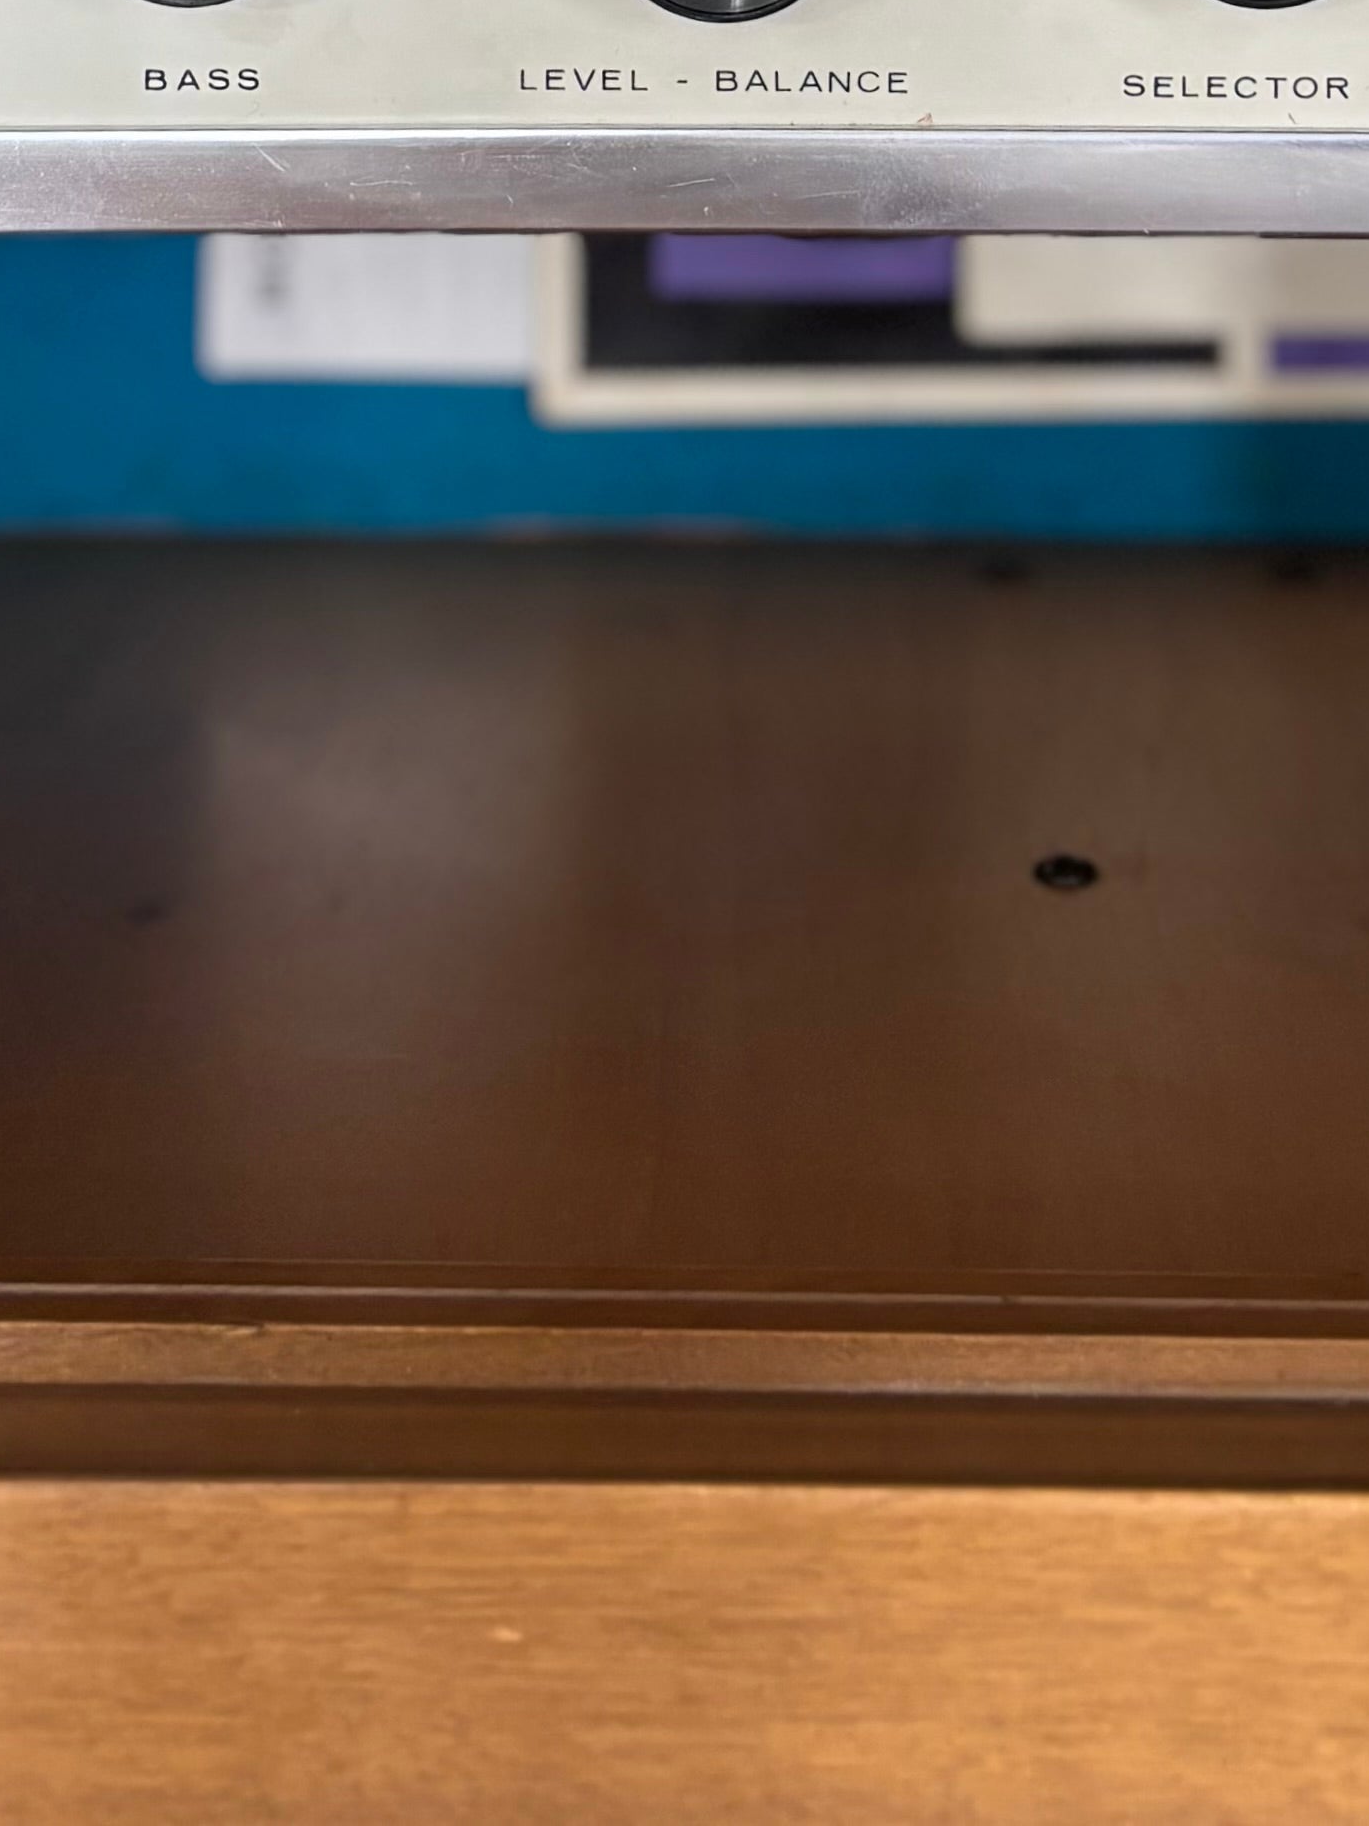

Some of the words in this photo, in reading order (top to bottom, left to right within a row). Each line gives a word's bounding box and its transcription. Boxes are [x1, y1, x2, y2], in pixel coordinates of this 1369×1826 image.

[144, 68, 260, 91] BASS
[520, 68, 649, 92] LEVEL
[715, 69, 908, 94] BALANCE
[1123, 74, 1349, 100] SELECTOR
